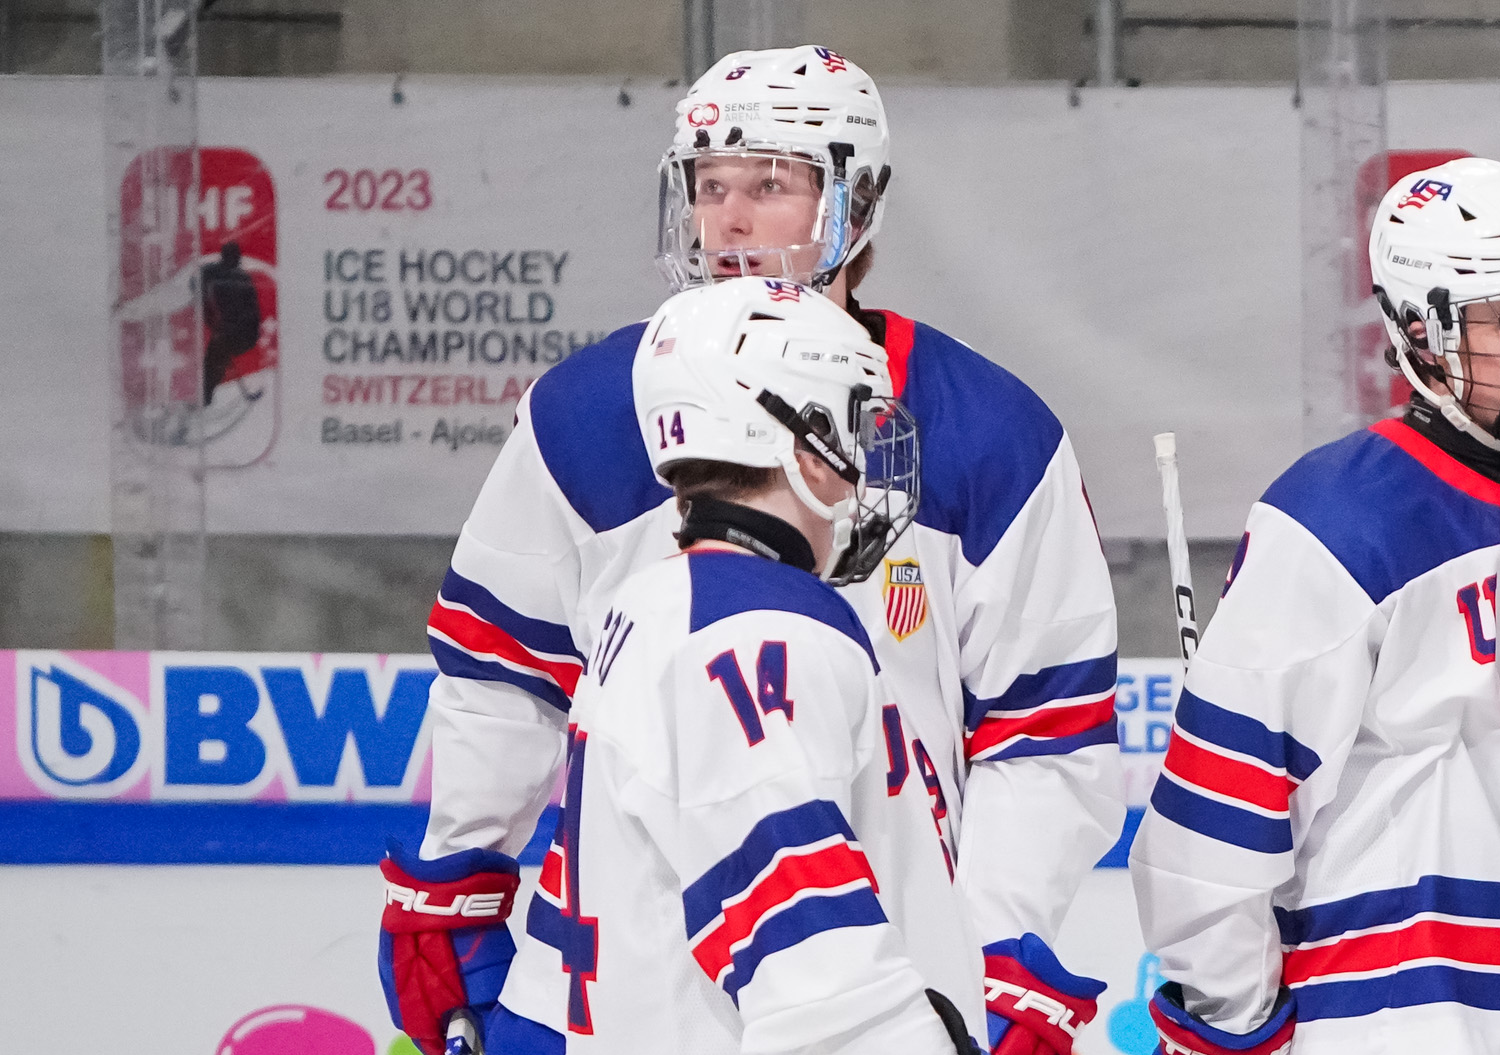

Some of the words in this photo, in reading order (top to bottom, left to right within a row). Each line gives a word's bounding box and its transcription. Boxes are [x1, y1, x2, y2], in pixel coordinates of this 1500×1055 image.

[724, 102, 762, 112] SENSE
[724, 113, 762, 122] ARENA
[846, 115, 878, 127] BAUER
[323, 168, 433, 212] 2023
[1397, 178, 1454, 209] USA
[324, 250, 388, 283] ICE
[399, 250, 570, 284] HOCKEY
[1391, 254, 1433, 271] BAUER
[323, 290, 393, 324] U18
[403, 290, 555, 325] WORLD
[323, 328, 612, 364] CHAMPIONSH
[322, 374, 537, 406] SWITZERLA
[321, 417, 404, 445] Basel
[430, 416, 507, 452] Ajoie
[657, 410, 686, 450] 14
[895, 565, 922, 582] USA
[1175, 584, 1200, 674] CC
[706, 640, 794, 748] 14
[164, 667, 438, 787] BW
[381, 882, 505, 917] RUE
[983, 976, 1086, 1040] TRU
